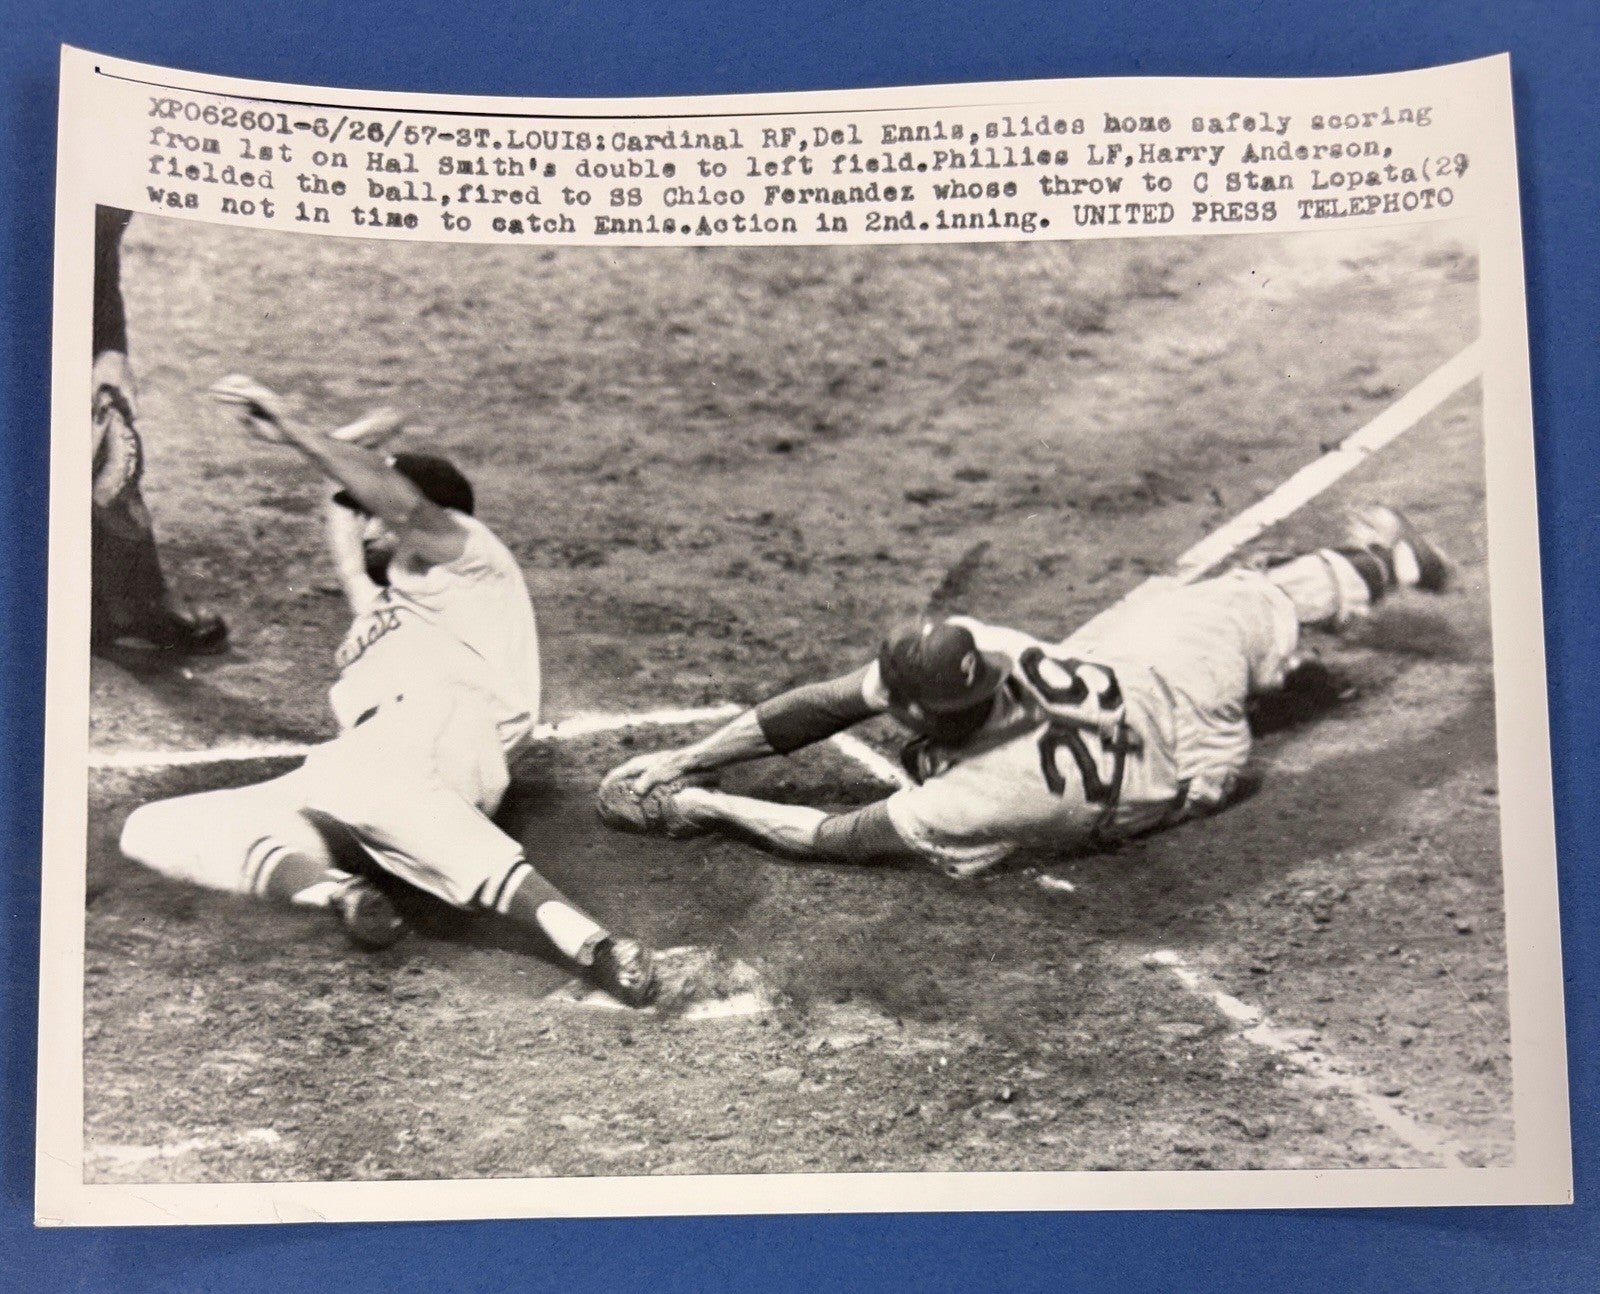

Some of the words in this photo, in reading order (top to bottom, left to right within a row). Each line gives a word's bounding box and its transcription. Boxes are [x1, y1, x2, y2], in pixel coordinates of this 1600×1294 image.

[1103, 112, 1172, 134] home
[1191, 111, 1292, 136] safely
[1311, 106, 1433, 131] scoring
[149, 126, 221, 154] from
[311, 150, 348, 168] on
[366, 151, 419, 174] Hal
[438, 155, 557, 178] Smith's
[575, 158, 676, 179] double
[697, 158, 727, 178] to
[746, 155, 813, 178] left
[1241, 140, 1393, 164] Anderson,
[148, 154, 274, 190] fielded
[296, 172, 347, 197] the
[561, 186, 592, 206] to
[610, 187, 643, 207] SS
[663, 185, 745, 208] Chico
[764, 181, 915, 206] Fernandez
[932, 178, 1018, 200] whose
[1038, 174, 1123, 197] throw
[1142, 172, 1173, 193] to
[1193, 171, 1209, 194] C
[1226, 170, 1294, 192] Stan
[146, 185, 199, 209] was
[220, 197, 275, 219] not
[295, 201, 330, 224] in
[351, 205, 419, 230] time
[440, 210, 472, 232] to
[491, 213, 576, 235] catch
[816, 212, 848, 233] in
[1073, 201, 1175, 227] UNITED
[1191, 200, 1278, 223] PRESS
[1297, 186, 1454, 220] TELEPHOTO
